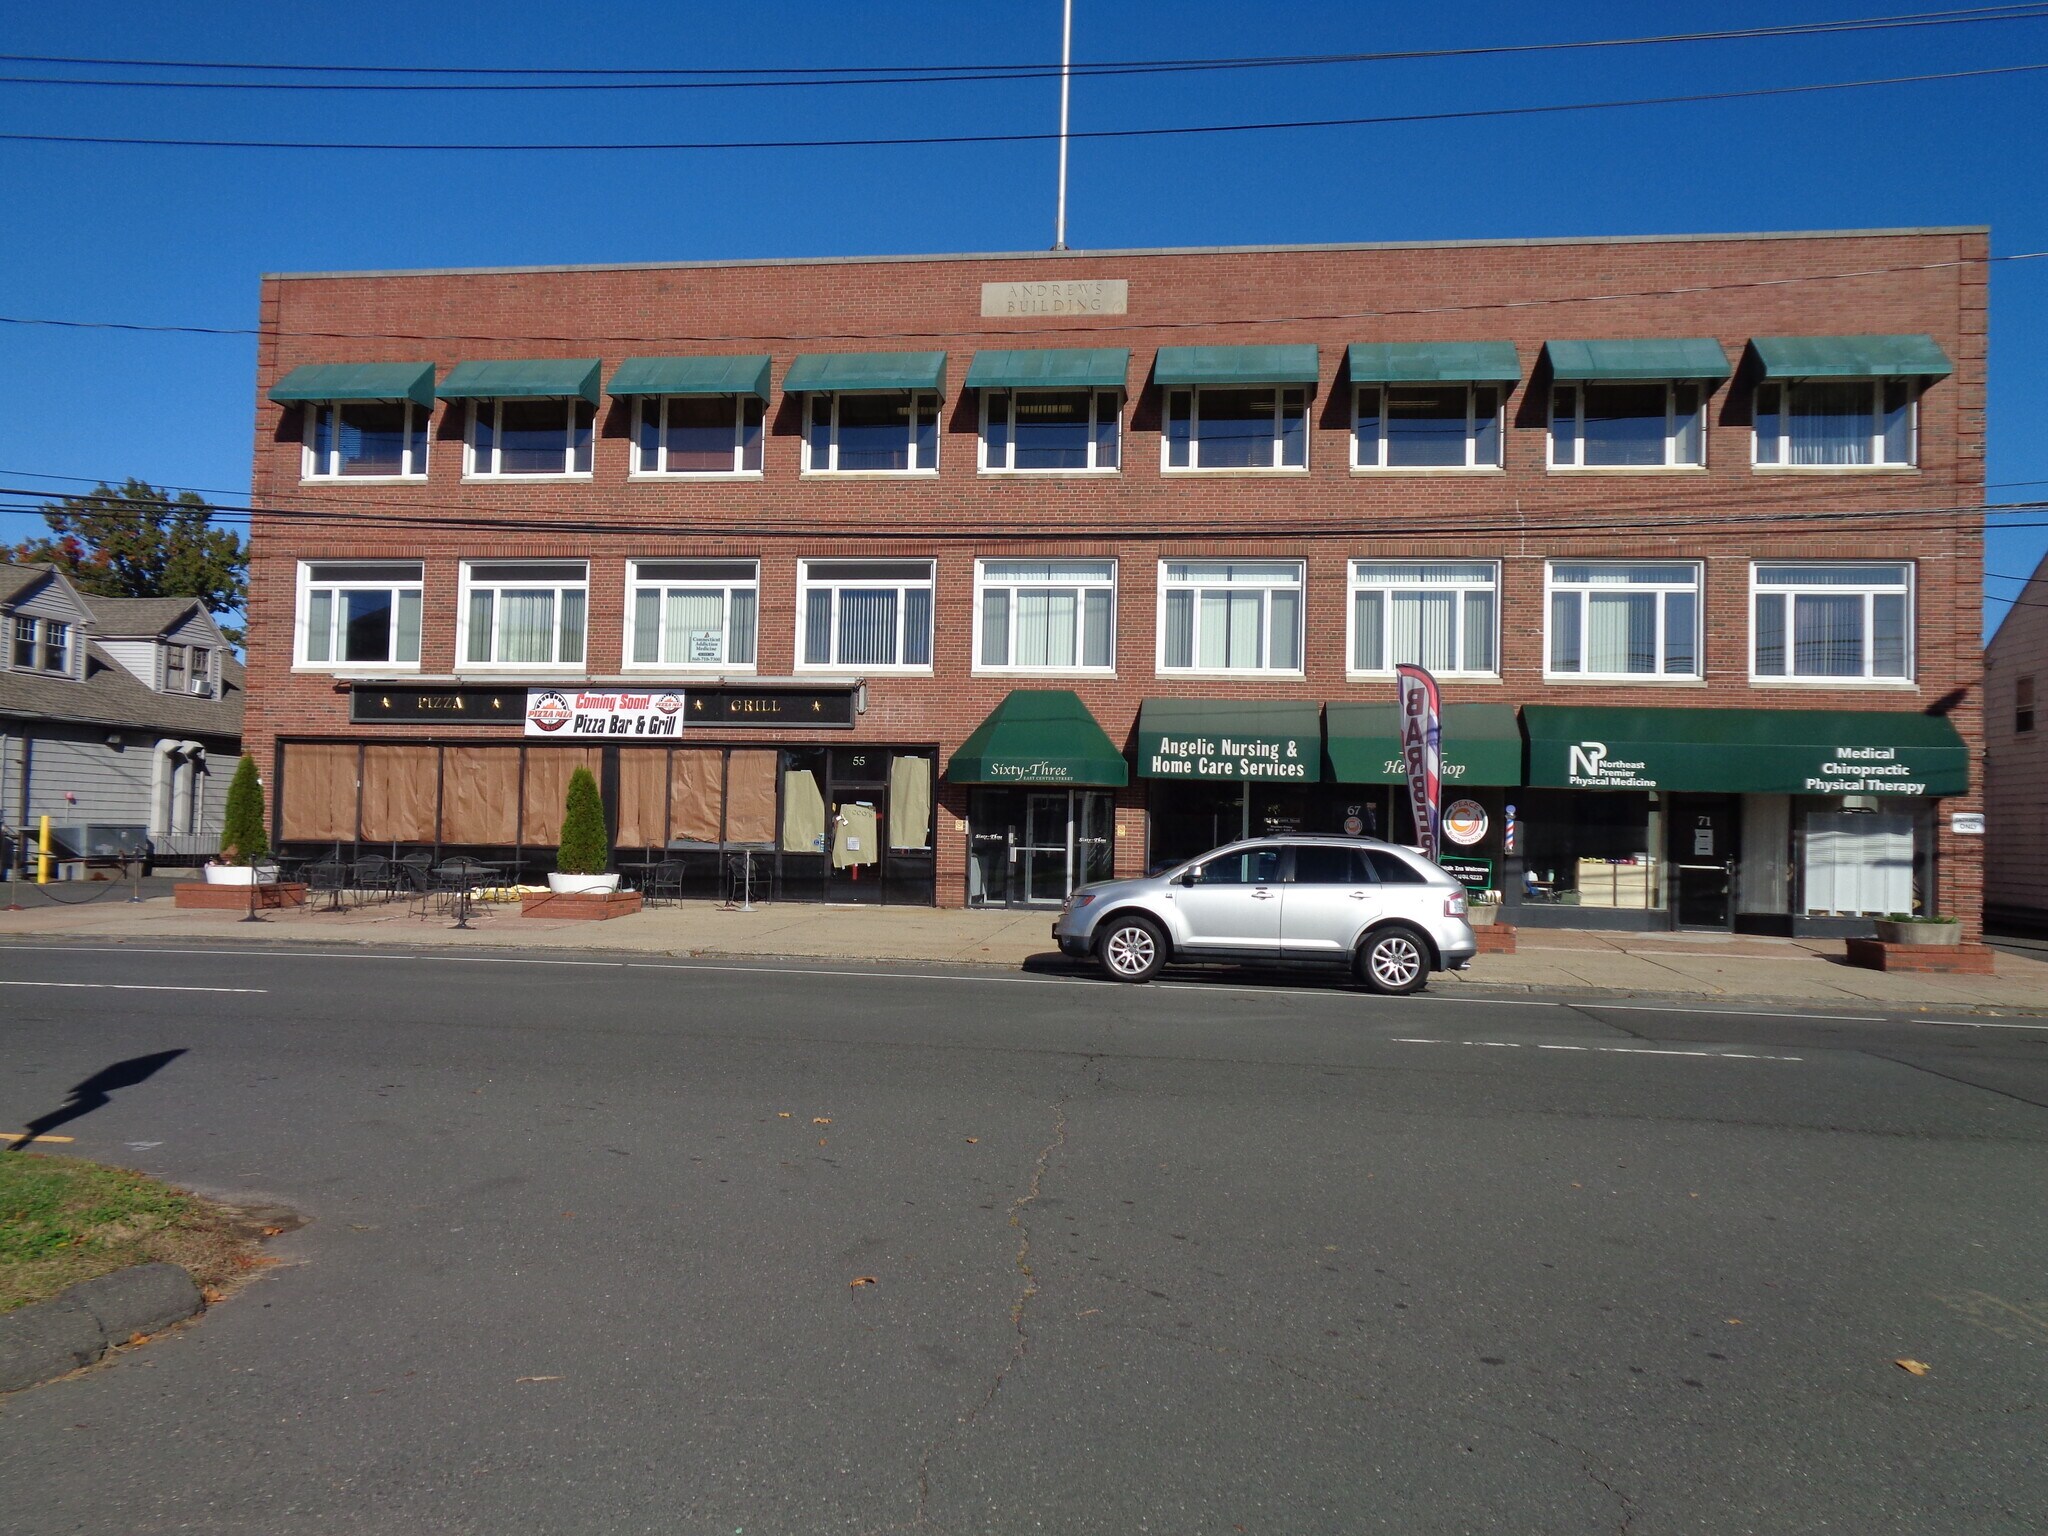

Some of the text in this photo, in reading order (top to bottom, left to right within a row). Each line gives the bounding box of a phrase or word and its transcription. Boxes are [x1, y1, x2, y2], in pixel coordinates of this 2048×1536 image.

[1008, 283, 1103, 298] ANDREWS
[1007, 299, 1101, 313] BUILDING
[417, 696, 464, 709] PIZZA
[575, 693, 652, 712] Coming Soon!
[731, 700, 781, 712] GRILL
[528, 710, 573, 718] PIZZA MIA
[573, 714, 677, 735] Pizza Bar & Grill
[1160, 737, 1298, 760] Angelic Nursing &
[1836, 748, 1895, 759] Medical
[852, 756, 866, 766] 55
[1152, 756, 1305, 777] Home Care Services
[1599, 760, 1646, 769] Northeast
[991, 761, 1067, 781] Sixty-Three
[1599, 768, 1636, 777] Premier
[1821, 763, 1910, 777] Chiropractic
[1569, 776, 1657, 787] Physical Medicine
[1805, 778, 1926, 795] Physical Therapy
[1347, 806, 1361, 815] 67
[1452, 801, 1480, 810] PEACE
[1698, 816, 1711, 826] 71
